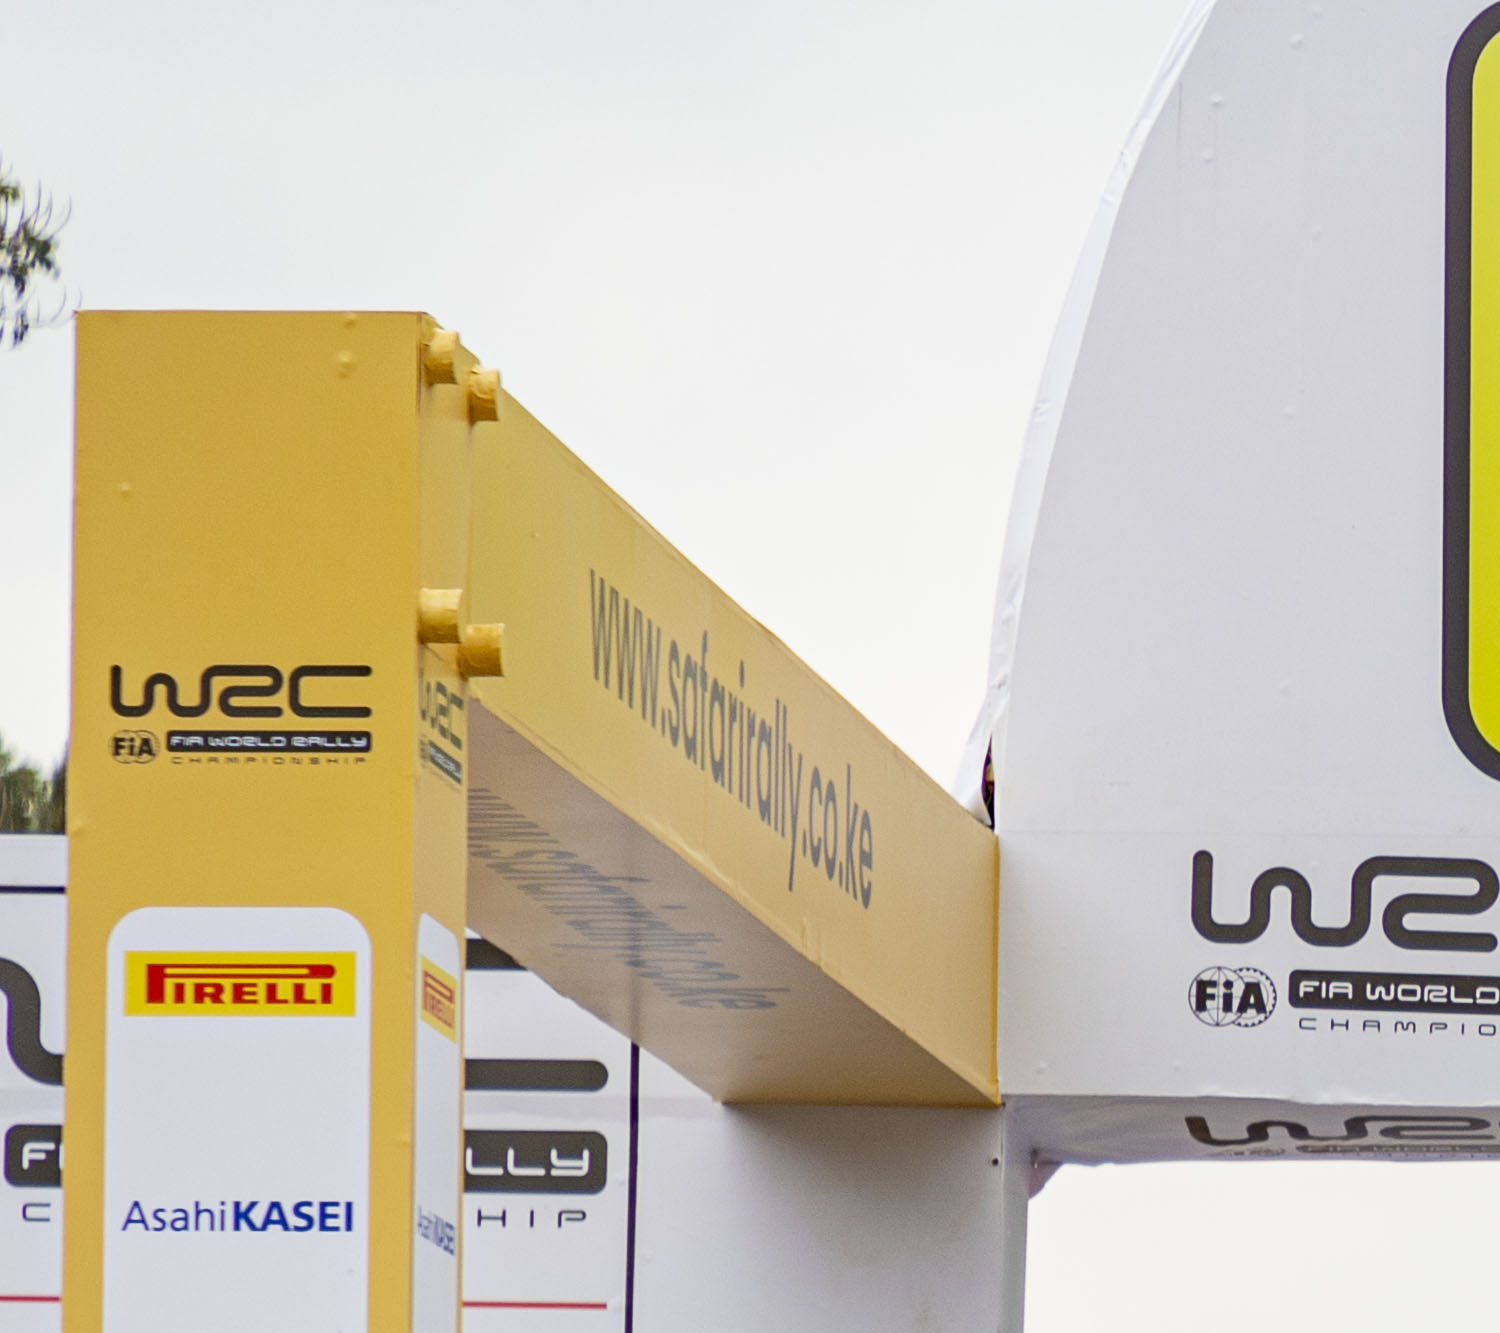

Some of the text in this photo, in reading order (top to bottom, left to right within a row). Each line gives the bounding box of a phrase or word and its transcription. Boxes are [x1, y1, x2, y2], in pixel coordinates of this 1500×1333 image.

[111, 665, 372, 718] WRC
[590, 561, 880, 910] www.safarirally.co.ke
[146, 964, 336, 1004] PIRELLI
[1299, 981, 1352, 999] FIA
[1366, 983, 1500, 1004] WORLD
